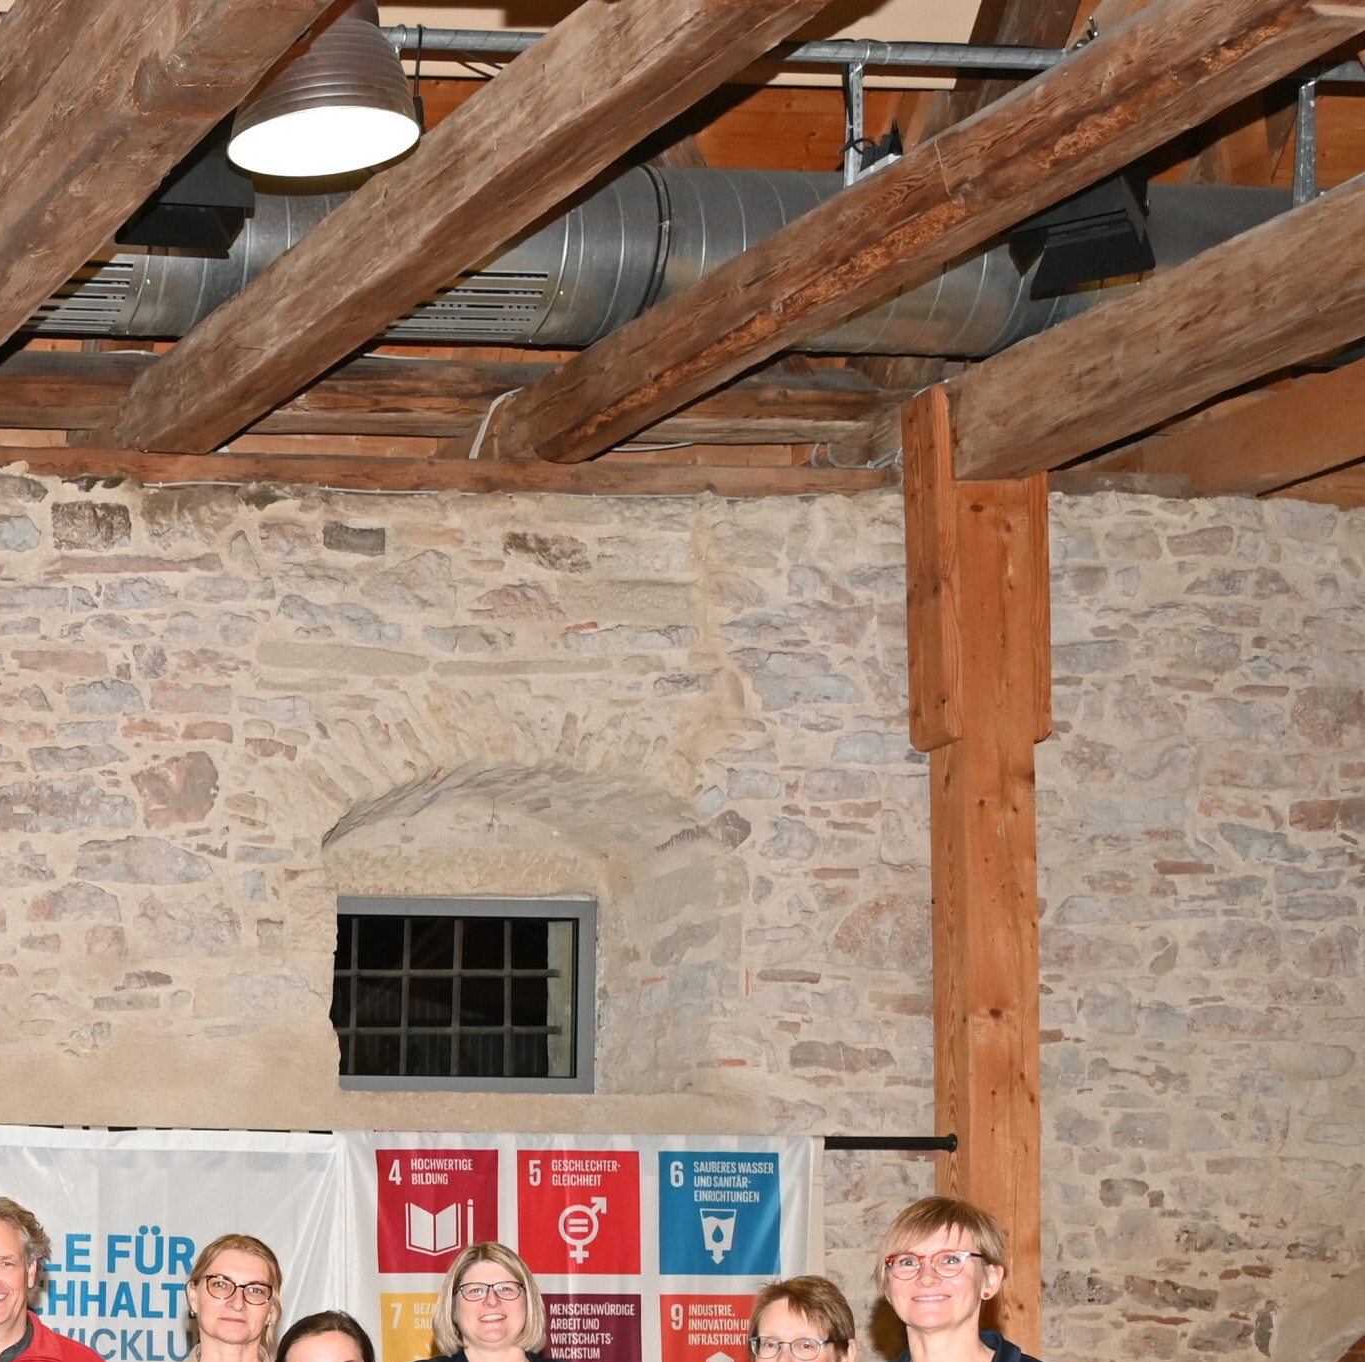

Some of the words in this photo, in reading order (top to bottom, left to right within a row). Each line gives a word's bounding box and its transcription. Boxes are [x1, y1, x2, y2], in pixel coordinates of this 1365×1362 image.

[411, 1158, 473, 1171] HOCHWERTIGE
[552, 1159, 621, 1173] GESCHLECHTER-
[693, 1161, 736, 1174] SAUBERES
[737, 1162, 774, 1174] WASSER
[388, 1159, 402, 1185] 4
[411, 1172, 448, 1185] BILDUNG
[528, 1159, 542, 1186] 5
[670, 1161, 684, 1187] 6
[552, 1174, 601, 1186] GLEICHHEIT
[694, 1176, 713, 1187] UND
[713, 1175, 751, 1188] SANITÄR-
[694, 1190, 760, 1203] EINRICHTUNGEN
[107, 1225, 196, 1276] FÜR
[550, 1302, 635, 1316] MENSCHENWÜRDIGE
[390, 1303, 403, 1330] 7
[671, 1304, 684, 1331] 9
[551, 1318, 581, 1330] ARBEIT
[583, 1318, 600, 1330] UND
[689, 1319, 740, 1331] INNOVATION
[551, 1333, 614, 1345] WIRTSCHAFTS-
[689, 1333, 749, 1346] INFRASTRUKT
[551, 1347, 600, 1360] WACHSTUM
